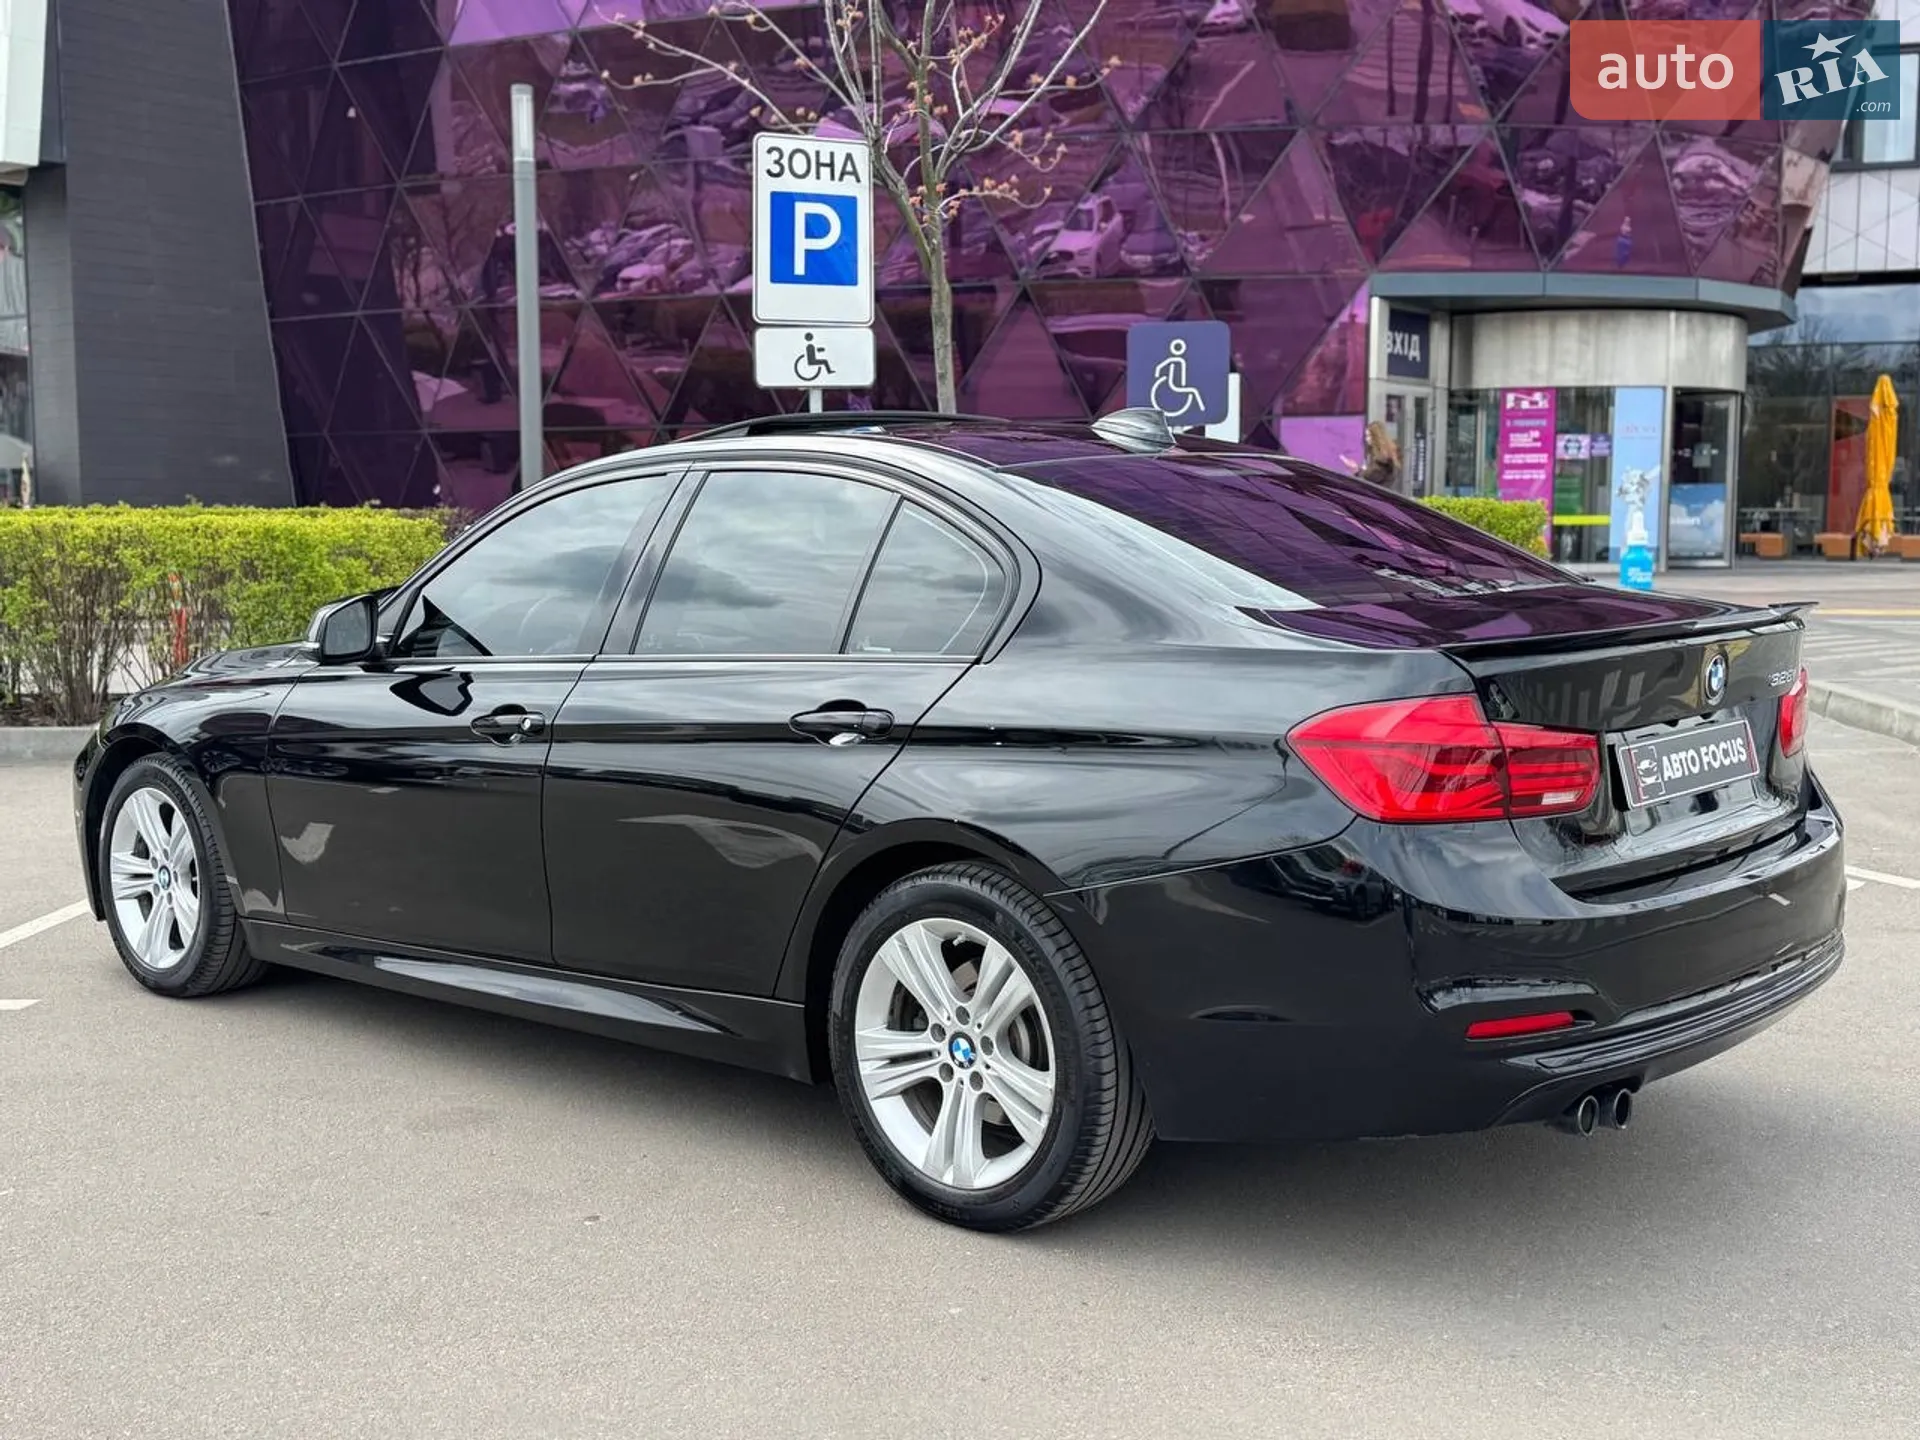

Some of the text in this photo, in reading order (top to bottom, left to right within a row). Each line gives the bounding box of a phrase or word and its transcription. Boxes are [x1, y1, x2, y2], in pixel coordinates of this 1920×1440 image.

[766, 147, 861, 183] ЗОНА
[794, 202, 841, 275] P
[1662, 737, 1747, 781] АВТО FOCUS
